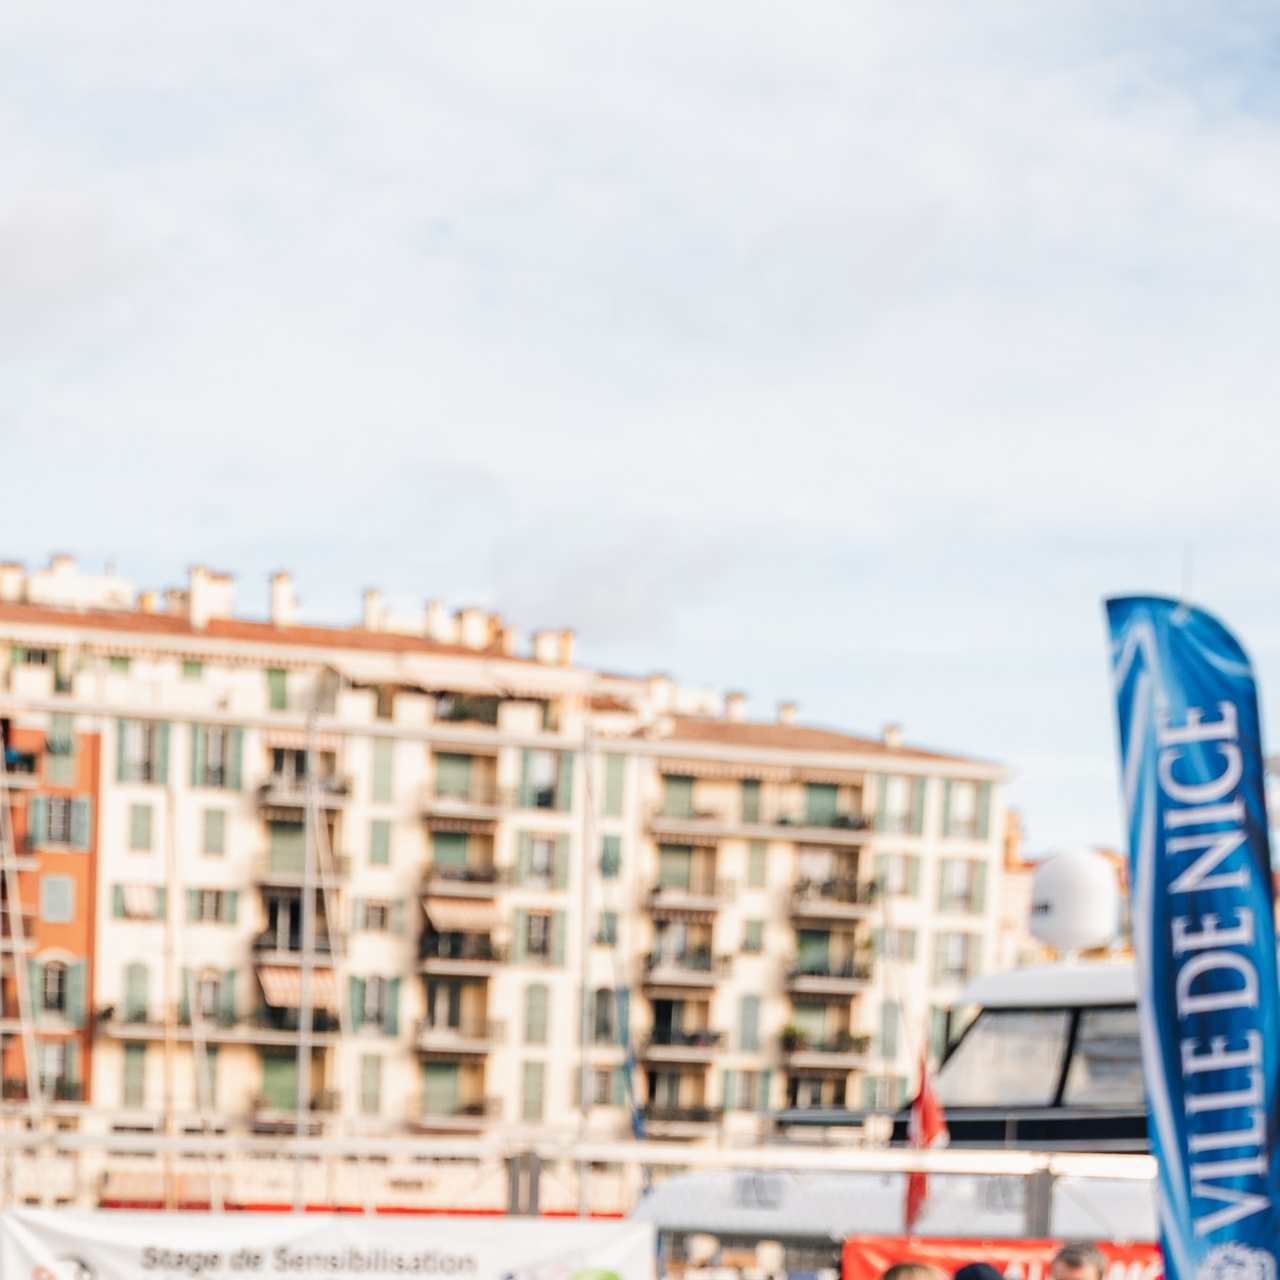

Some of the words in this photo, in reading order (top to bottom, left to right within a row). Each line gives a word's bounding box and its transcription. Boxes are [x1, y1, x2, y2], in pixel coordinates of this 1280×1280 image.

[1155, 700, 1251, 896] NICE
[1173, 905, 1261, 1018] DE
[1181, 1027, 1272, 1236] VILLE
[139, 1246, 221, 1274] Stage
[228, 1247, 262, 1272] de
[272, 1246, 478, 1276] Sensibilisation
